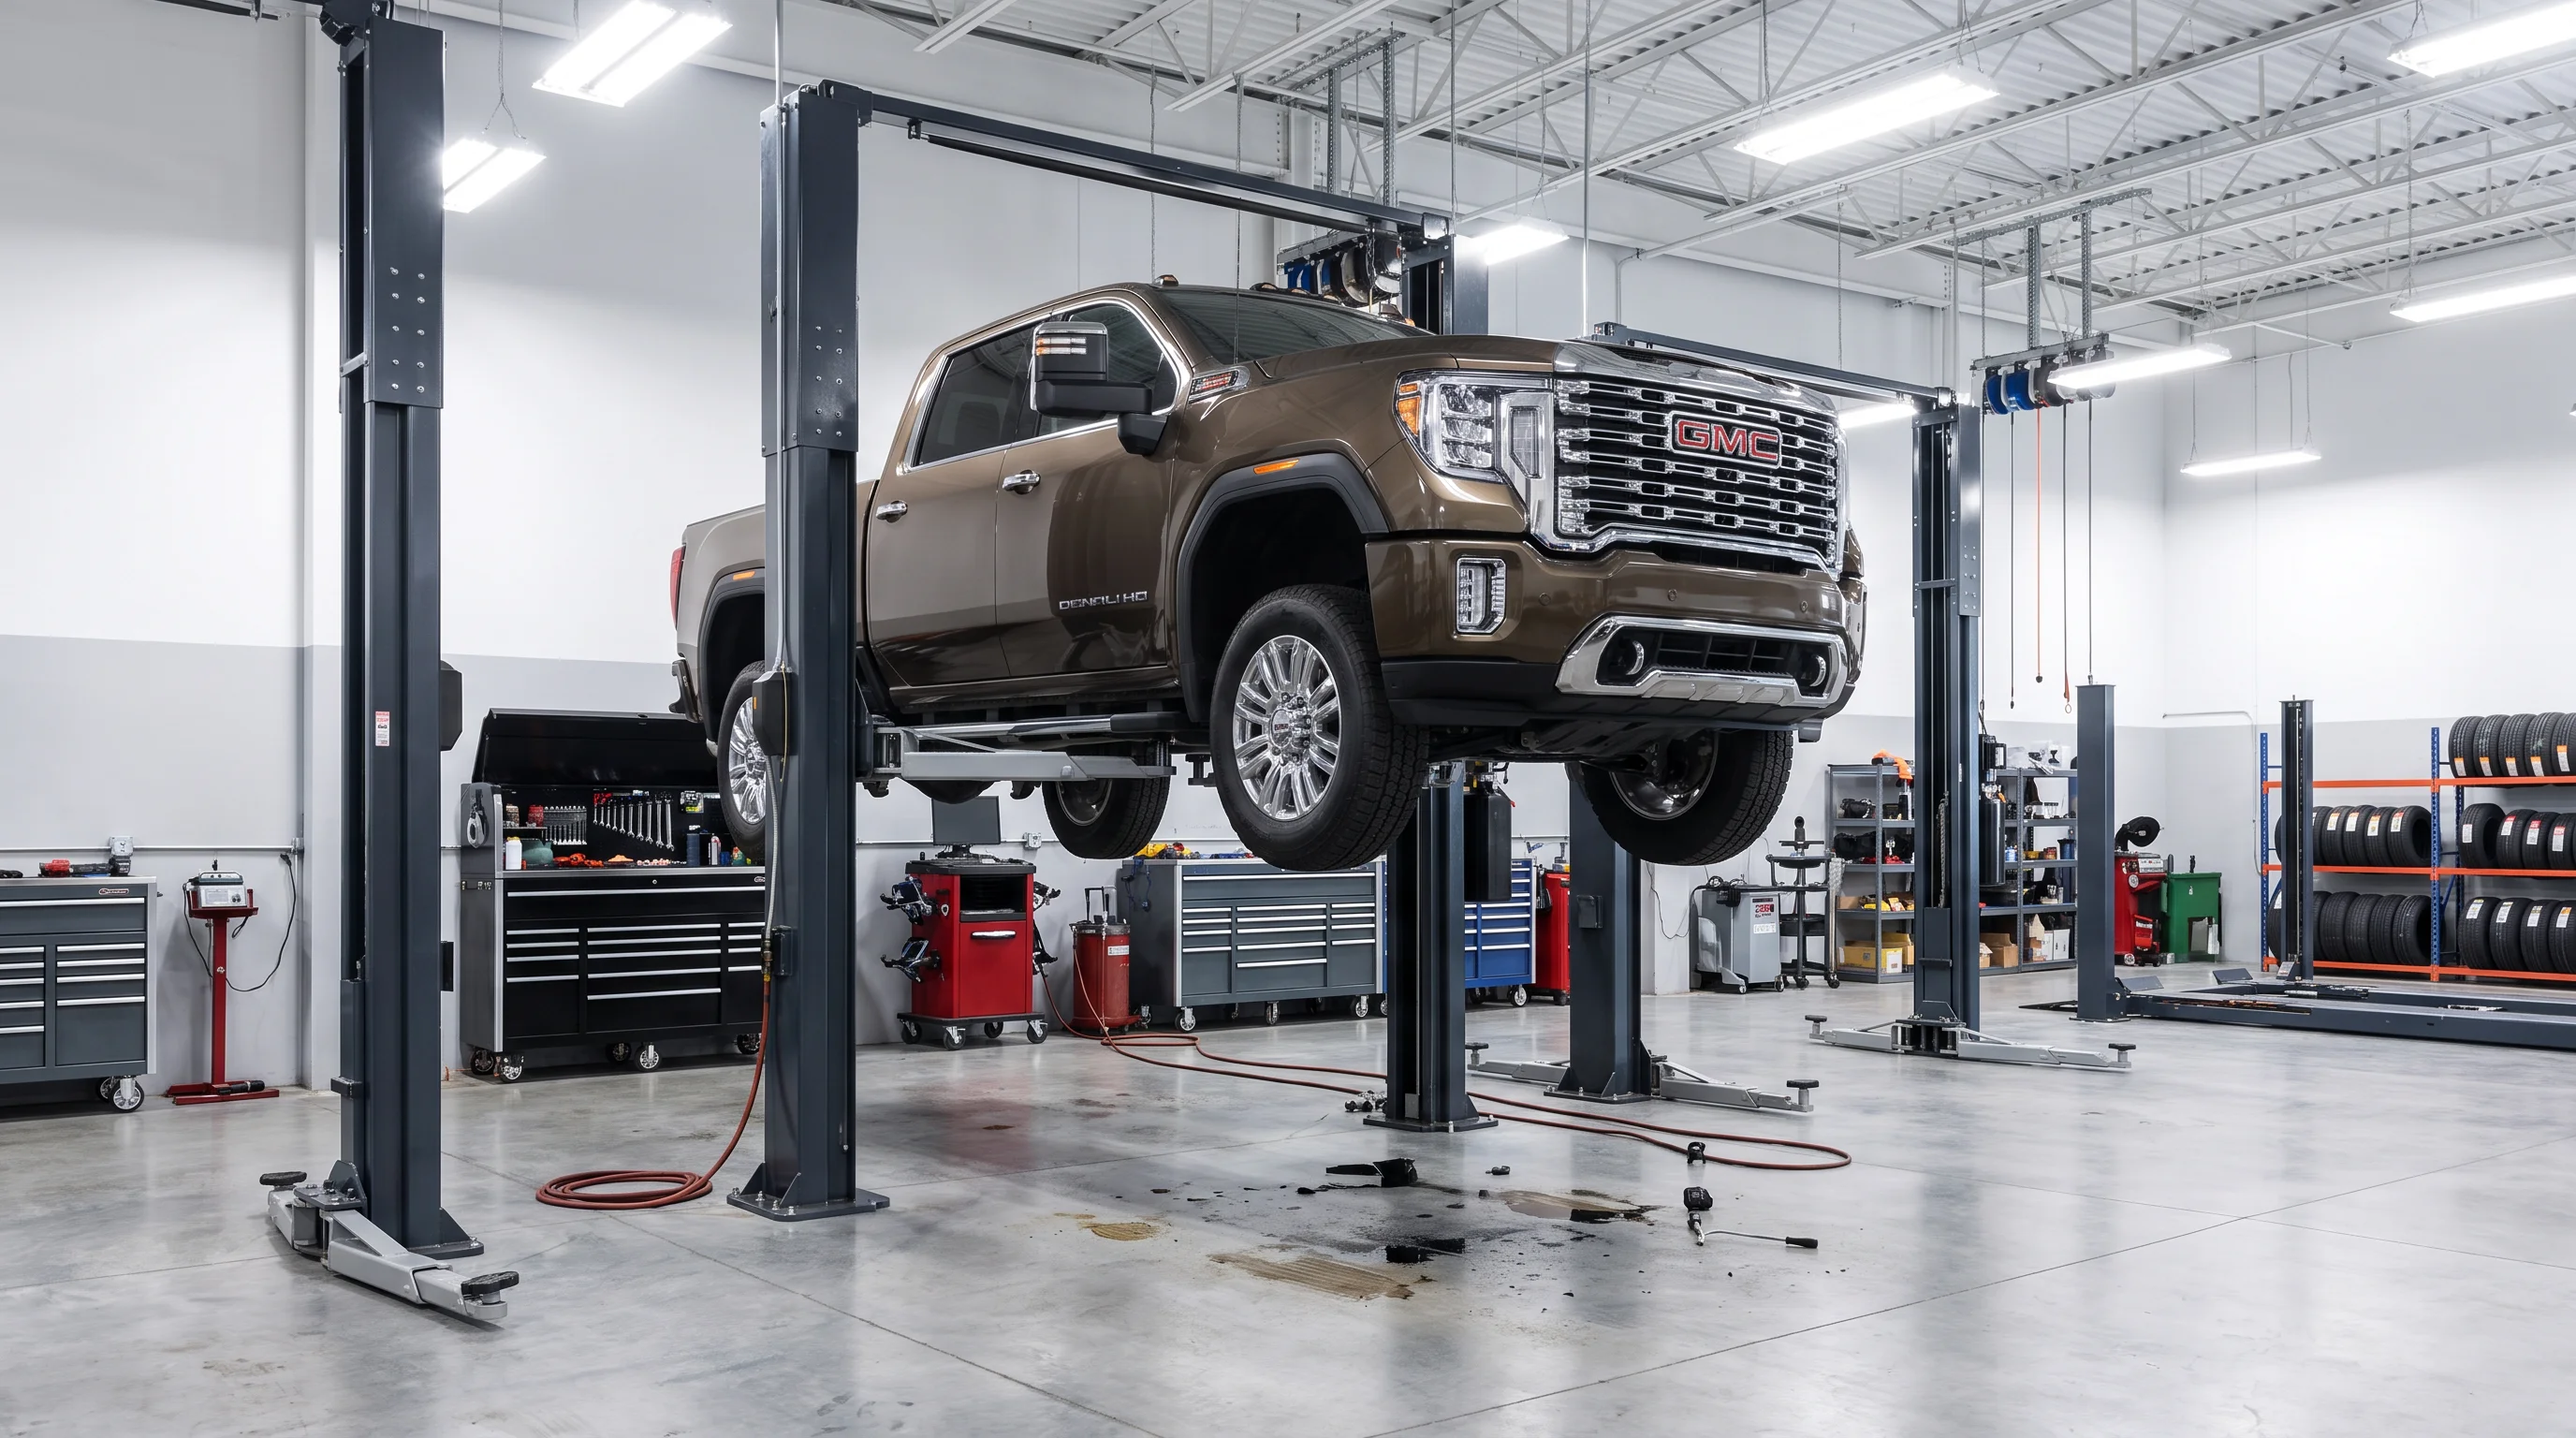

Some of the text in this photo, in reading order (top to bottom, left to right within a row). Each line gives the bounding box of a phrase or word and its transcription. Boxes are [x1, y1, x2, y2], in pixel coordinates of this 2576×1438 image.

[1676, 420, 1778, 461] GMC
[1059, 591, 1148, 609] DENALI HD
